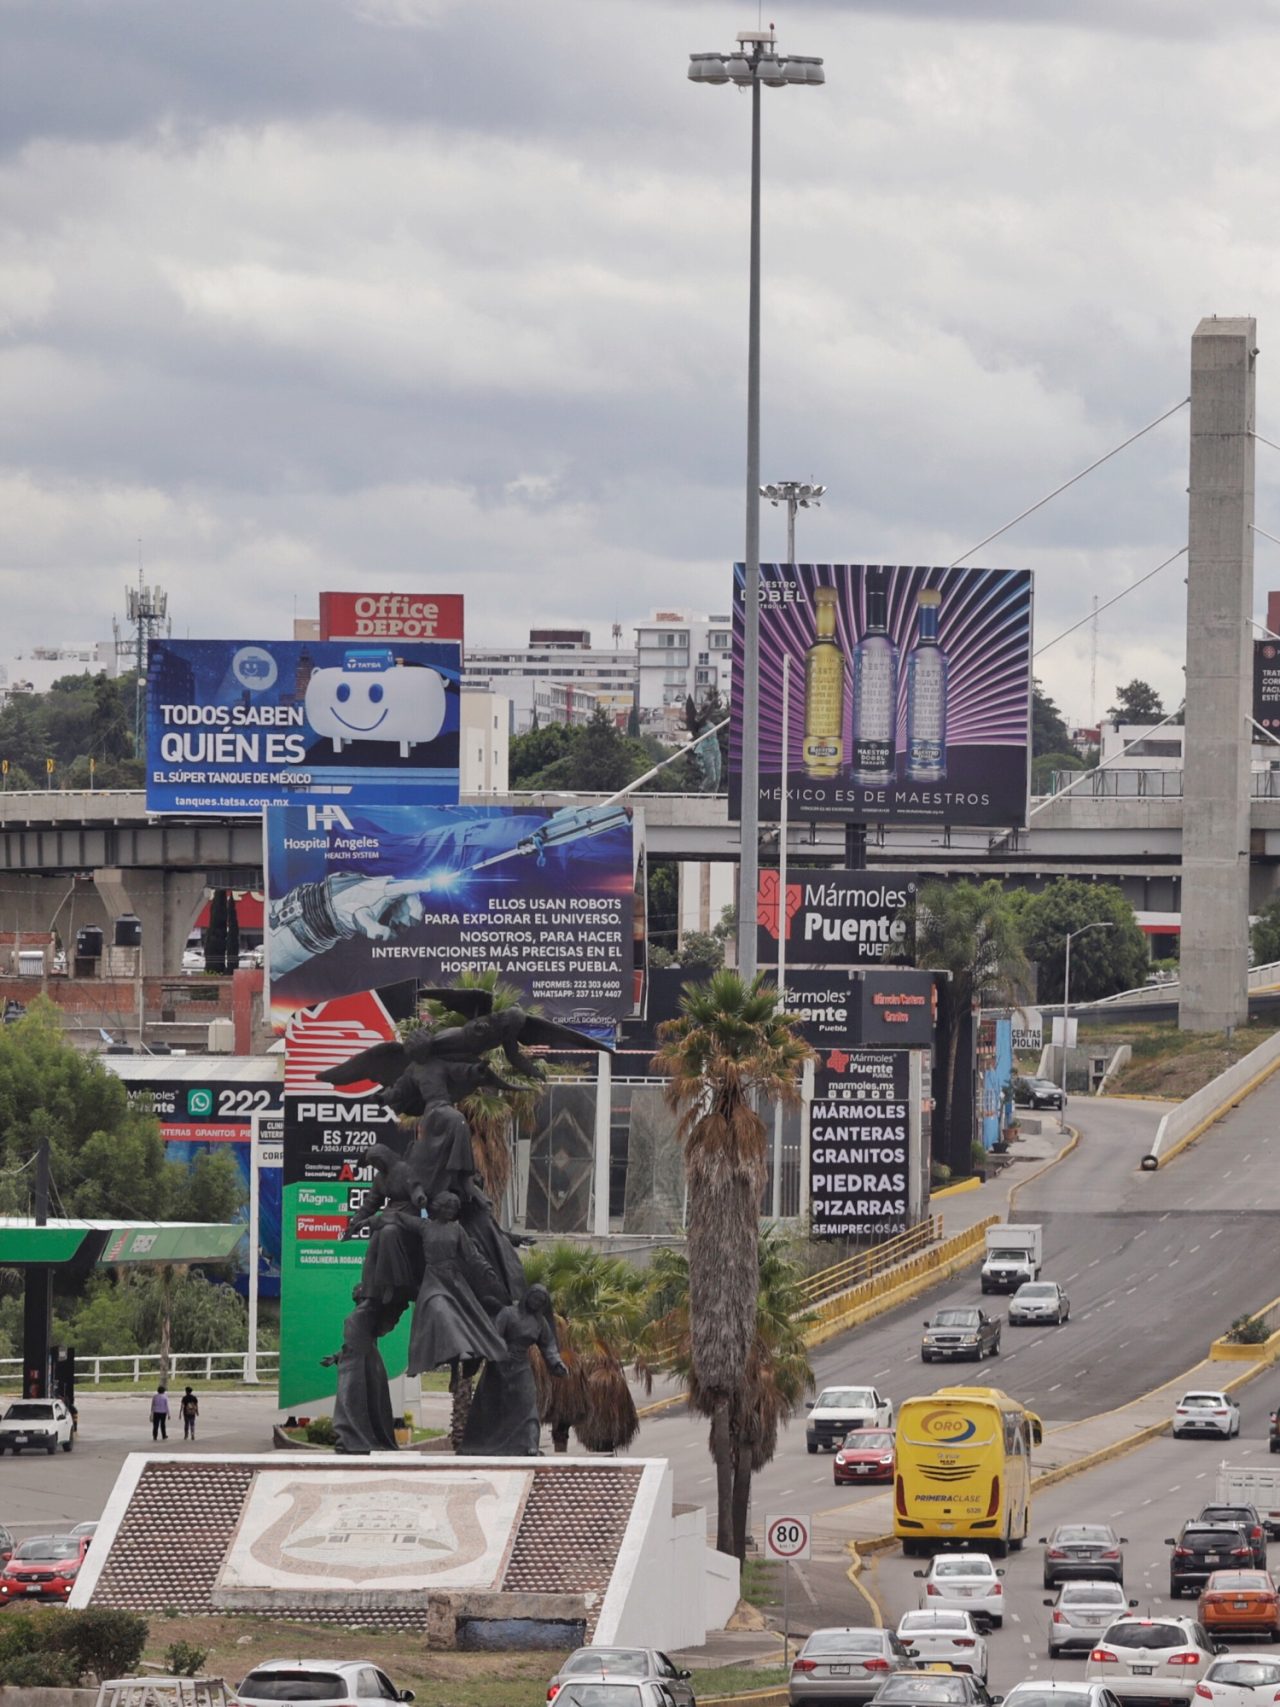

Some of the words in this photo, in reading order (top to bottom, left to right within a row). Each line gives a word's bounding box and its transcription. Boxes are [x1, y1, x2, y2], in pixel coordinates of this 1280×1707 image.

[759, 581, 797, 589] AESTRO
[354, 596, 440, 620] Office
[355, 619, 438, 637] DEPOT
[357, 661, 382, 669] TATSA
[160, 704, 230, 726] TODOS
[232, 705, 303, 726] SABEN
[160, 727, 263, 764] QUIÉN
[266, 734, 306, 764] ES
[153, 772, 168, 784] EL
[168, 769, 206, 785] SÚPER
[207, 772, 252, 786] TANQUE
[253, 773, 268, 785] DE
[269, 771, 311, 785] MÉXICO
[175, 796, 289, 808] tanques.tatsa.com.mx
[759, 787, 826, 802] MÉXICO
[835, 789, 856, 802] ES
[864, 790, 886, 803] DE
[895, 791, 991, 805] MAESTROS
[283, 836, 330, 852] Hospital
[334, 836, 379, 851] Angeles
[324, 852, 351, 860] HEALTH
[352, 851, 379, 859] SYSTEM
[804, 882, 907, 908] Mármoles
[488, 898, 527, 911] ELLOS
[529, 898, 566, 910] USAN
[569, 898, 622, 910] ROBOTS
[424, 913, 461, 925] PARA
[463, 913, 532, 925] EXPLORAR
[534, 913, 549, 925] EL
[551, 913, 622, 925] UNIVERSO.
[804, 911, 907, 943] Puente
[460, 931, 537, 945] NOSOTROS,
[540, 931, 575, 943] PARA
[578, 931, 622, 943] HACER
[371, 946, 487, 959] INTERVENCIONES
[489, 943, 520, 958] MÁS
[521, 946, 584, 958] PRECISAS
[586, 946, 605, 957] EN
[608, 946, 622, 957] EL
[440, 961, 503, 973] HOSPITAL
[506, 960, 566, 973] ANGELES
[568, 961, 622, 972] PUEBLA.
[532, 980, 573, 989] INFORMES:
[573, 980, 587, 989] 222
[587, 980, 601, 989] 303
[602, 980, 620, 989] 6600
[532, 990, 575, 998] WHATSAPP:
[575, 990, 589, 998] 237
[590, 990, 603, 998] 119
[604, 990, 622, 998] 4407
[819, 1024, 848, 1032] Puebla
[1011, 1029, 1041, 1038] CEMITAS
[1011, 1039, 1041, 1048] PIOLIN
[849, 1053, 894, 1063] Mármoles
[849, 1063, 894, 1074] Puente
[828, 1081, 895, 1091] marmoles.mx
[126, 1089, 176, 1101] Moles
[126, 1101, 176, 1114] Pnte
[217, 1090, 271, 1117] 222
[297, 1103, 401, 1123] PEMEX
[812, 1102, 906, 1119] MÁRMOLES
[195, 1129, 236, 1137] GRANITOS
[323, 1130, 342, 1145] ES
[344, 1131, 377, 1146] 7220
[812, 1126, 906, 1141] CANTERAS
[812, 1148, 906, 1164] GRANITOS
[812, 1174, 906, 1193] PIEDRAS
[813, 1199, 906, 1216] PIZARRAS
[812, 1223, 906, 1235] SEMIPRECIOSAS
[933, 1421, 963, 1431] ORO
[776, 1526, 799, 1543] 80
